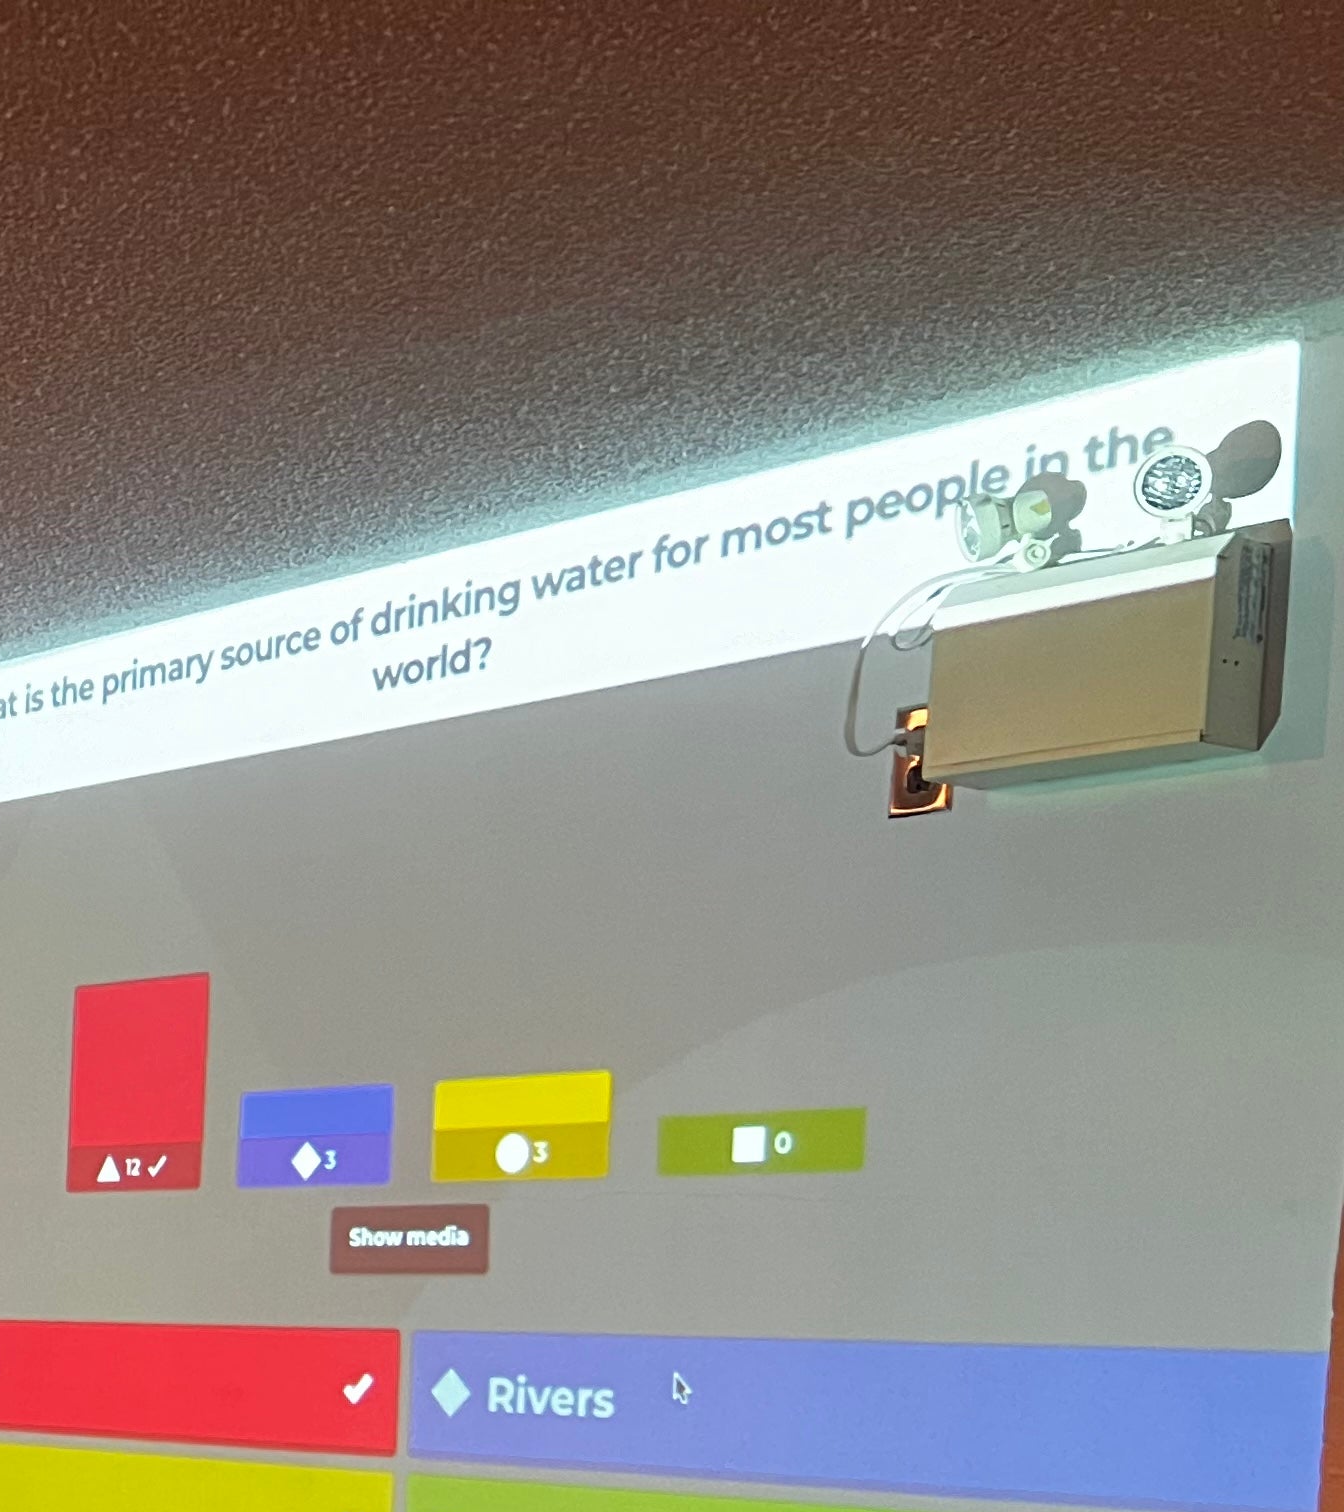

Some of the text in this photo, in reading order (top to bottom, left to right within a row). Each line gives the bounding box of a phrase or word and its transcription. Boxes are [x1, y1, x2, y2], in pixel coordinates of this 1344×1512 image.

[25, 683, 44, 714] is
[51, 675, 94, 707] the
[102, 649, 214, 704] primary
[220, 624, 321, 671] source
[329, 606, 365, 646] of
[370, 579, 521, 637] drinking
[531, 548, 644, 600] water
[652, 533, 710, 573] for
[720, 501, 833, 558] most
[845, 459, 1010, 539] people
[1025, 444, 1069, 481] in
[1084, 426, 1174, 473] the
[372, 637, 493, 691] world?
[324, 1150, 337, 1170] 3
[532, 1142, 548, 1164] 3
[125, 1157, 141, 1177] 12
[349, 1224, 470, 1248] Show media
[487, 1375, 616, 1419] Rivers
